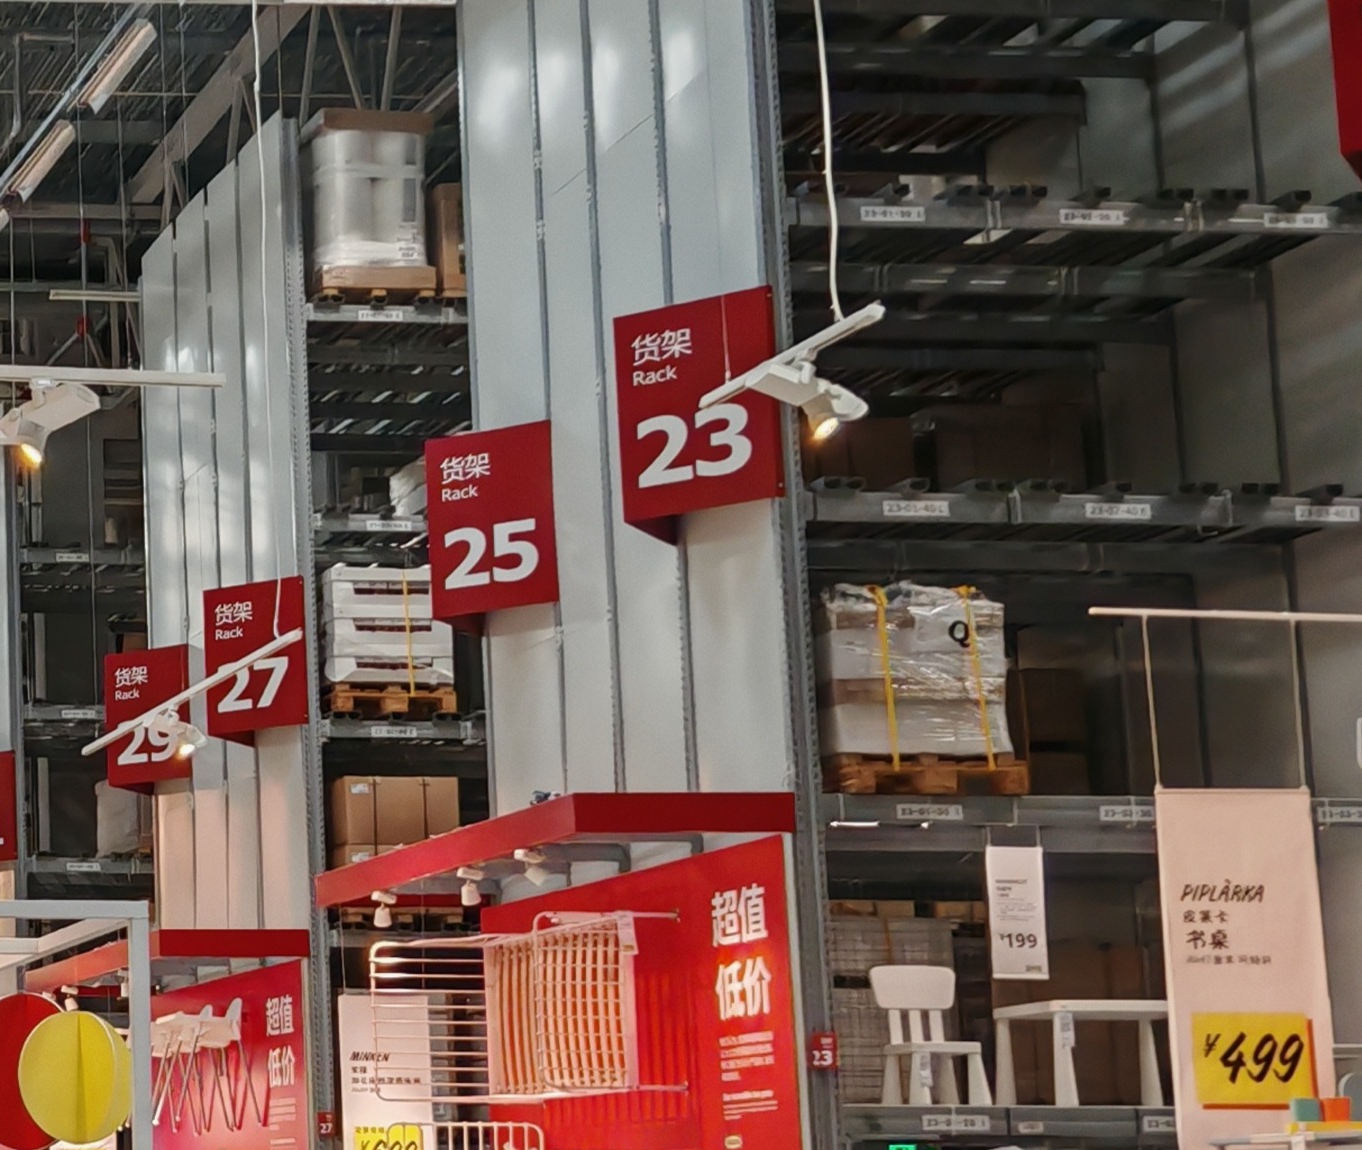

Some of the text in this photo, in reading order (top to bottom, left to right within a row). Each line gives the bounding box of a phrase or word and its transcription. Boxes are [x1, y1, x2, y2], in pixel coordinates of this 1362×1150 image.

[631, 327, 692, 367] 货架
[632, 366, 677, 386] Rack
[636, 402, 753, 489] 23
[440, 452, 491, 485] 货架
[441, 484, 478, 502] Rack
[443, 518, 540, 591] 25
[214, 601, 253, 626] 货架
[215, 626, 243, 640] Rack
[114, 665, 148, 687] 货架
[114, 687, 140, 701] Rack
[217, 656, 289, 713] 27
[117, 720, 175, 766] 29
[711, 883, 768, 948] 超值
[1000, 932, 1038, 949] ¥199
[715, 956, 772, 1021] 低价
[265, 995, 295, 1037] 超值
[267, 1046, 296, 1088] 低价
[1203, 1031, 1305, 1085] ¥499
